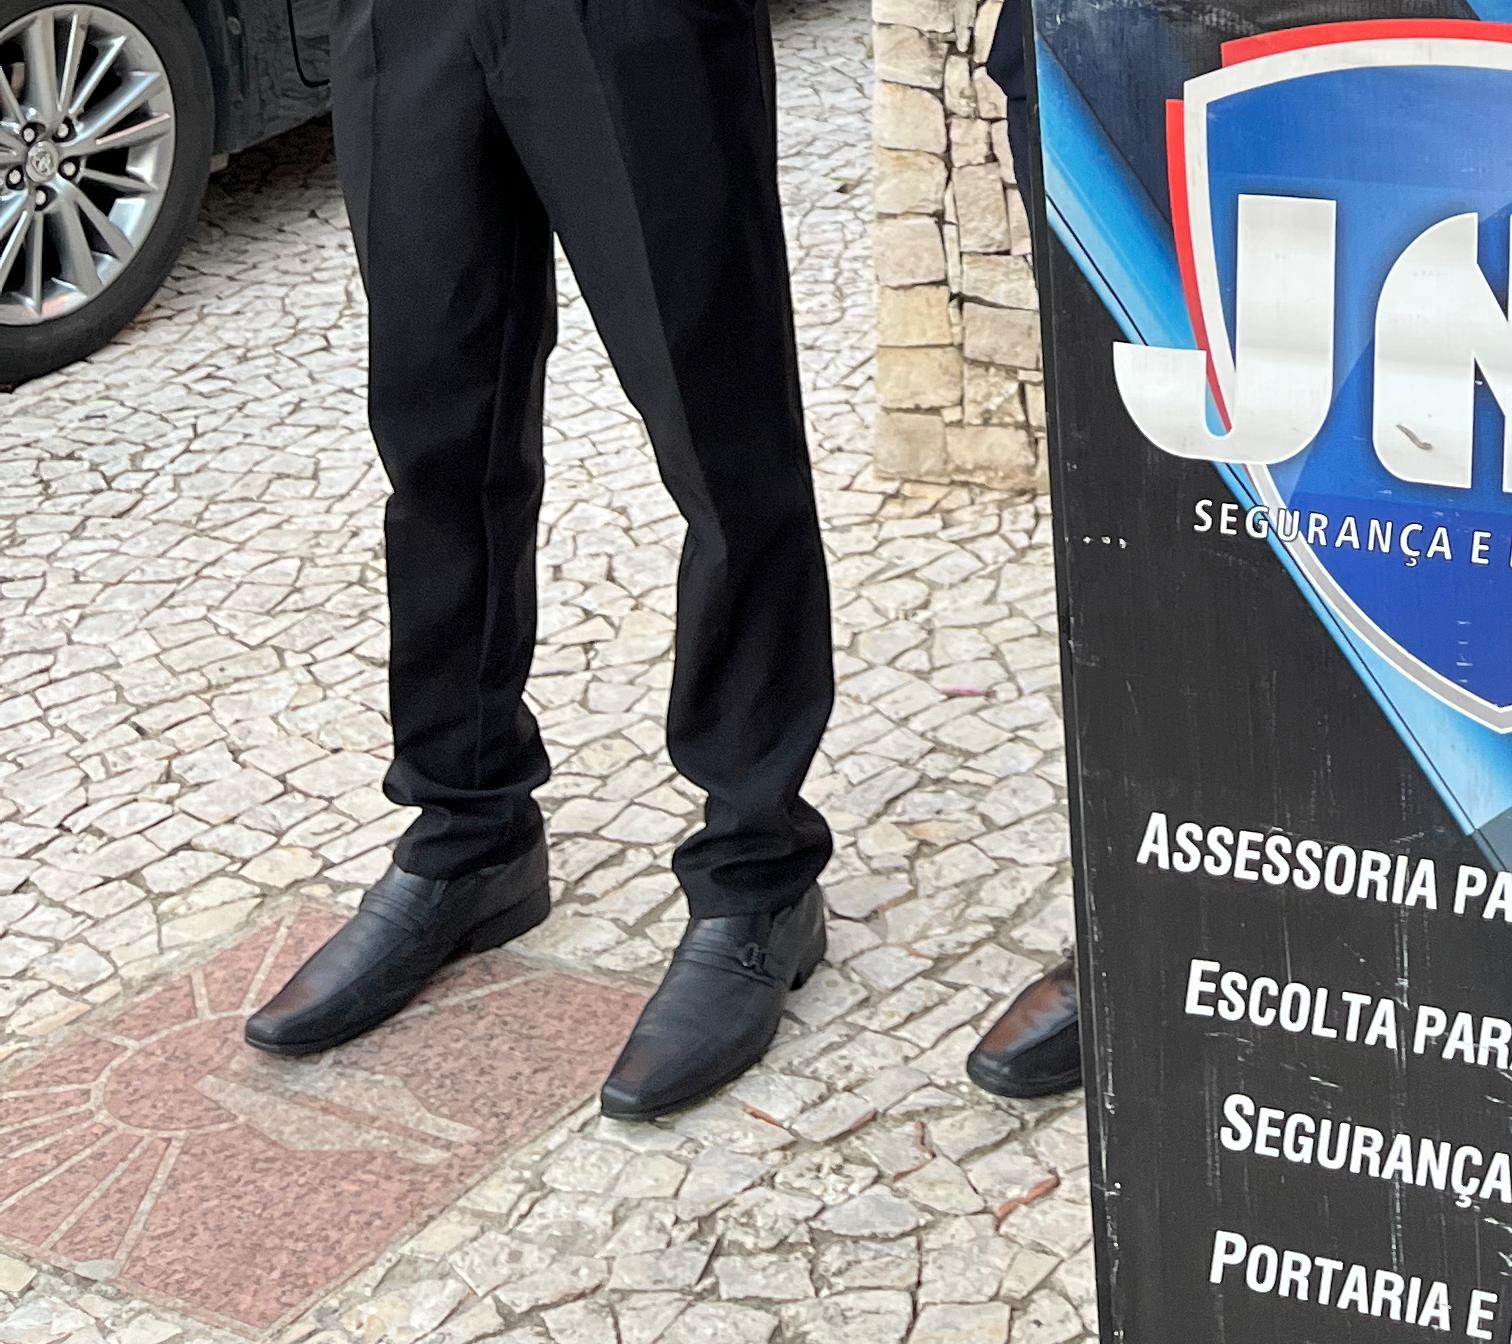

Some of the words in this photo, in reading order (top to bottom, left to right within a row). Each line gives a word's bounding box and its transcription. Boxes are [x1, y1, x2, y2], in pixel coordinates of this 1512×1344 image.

[1193, 499, 1453, 568] SEGURANÇA
[1471, 530, 1492, 565] E
[1136, 812, 1438, 910] ASSESSORIA
[1184, 958, 1399, 1056] ESCOLTA
[1220, 1093, 1512, 1209] SEGURANÇA
[1209, 1230, 1453, 1332] PORTARIA
[1466, 1289, 1499, 1342] E
